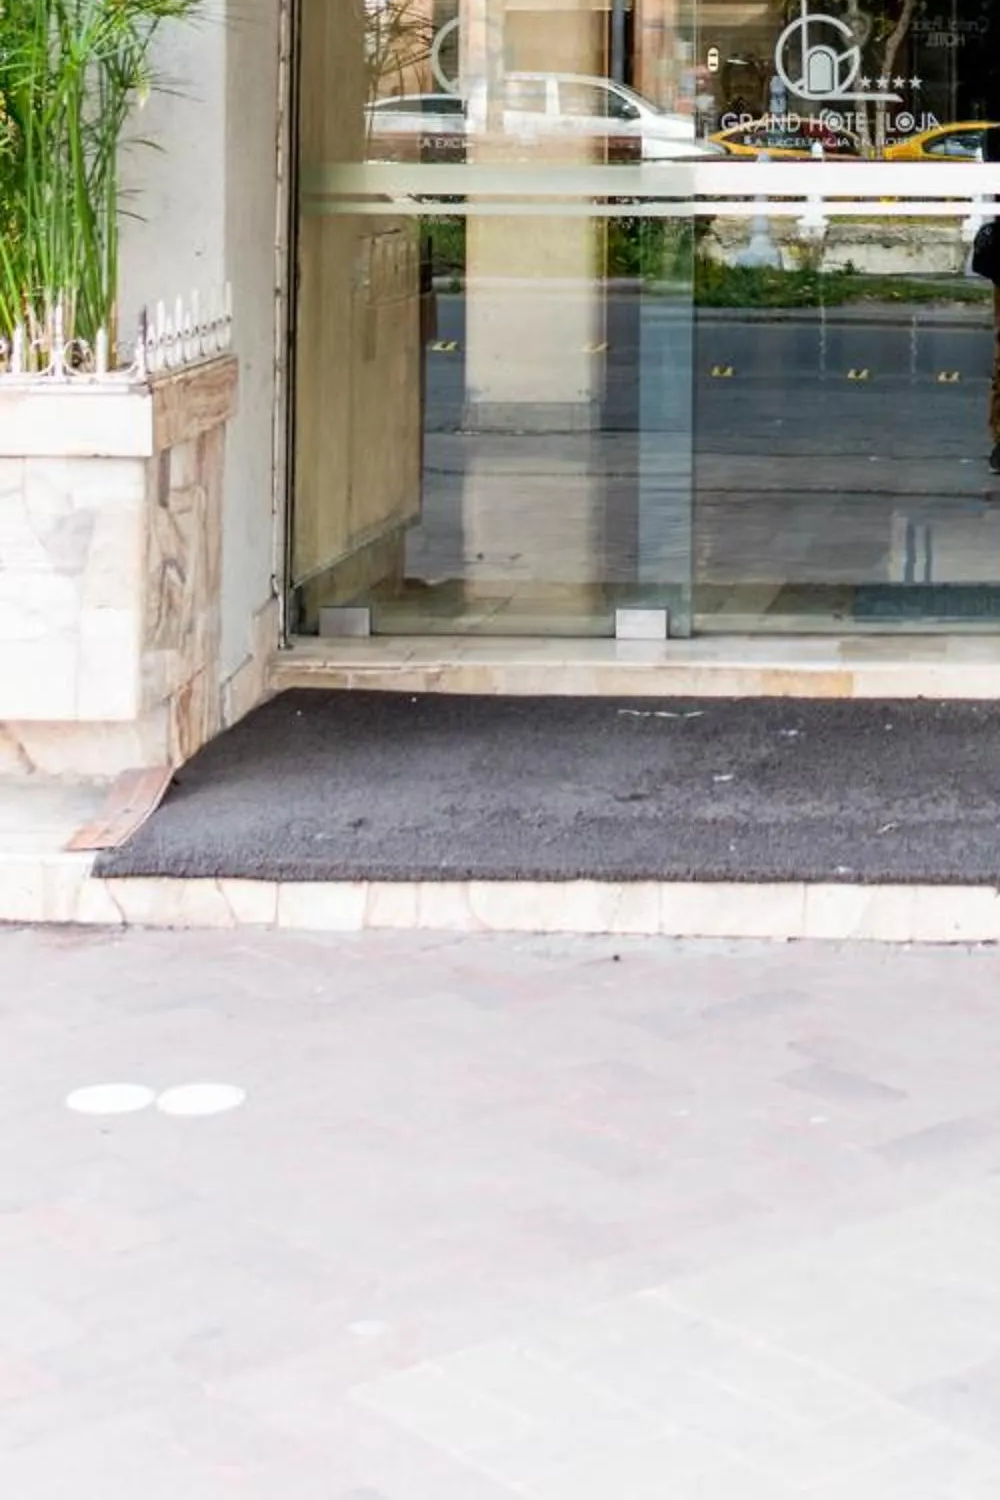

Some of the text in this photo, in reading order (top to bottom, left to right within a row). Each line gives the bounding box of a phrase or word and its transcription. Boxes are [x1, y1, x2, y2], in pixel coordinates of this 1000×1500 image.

[721, 108, 942, 133] GRAND HOTE LOJA
